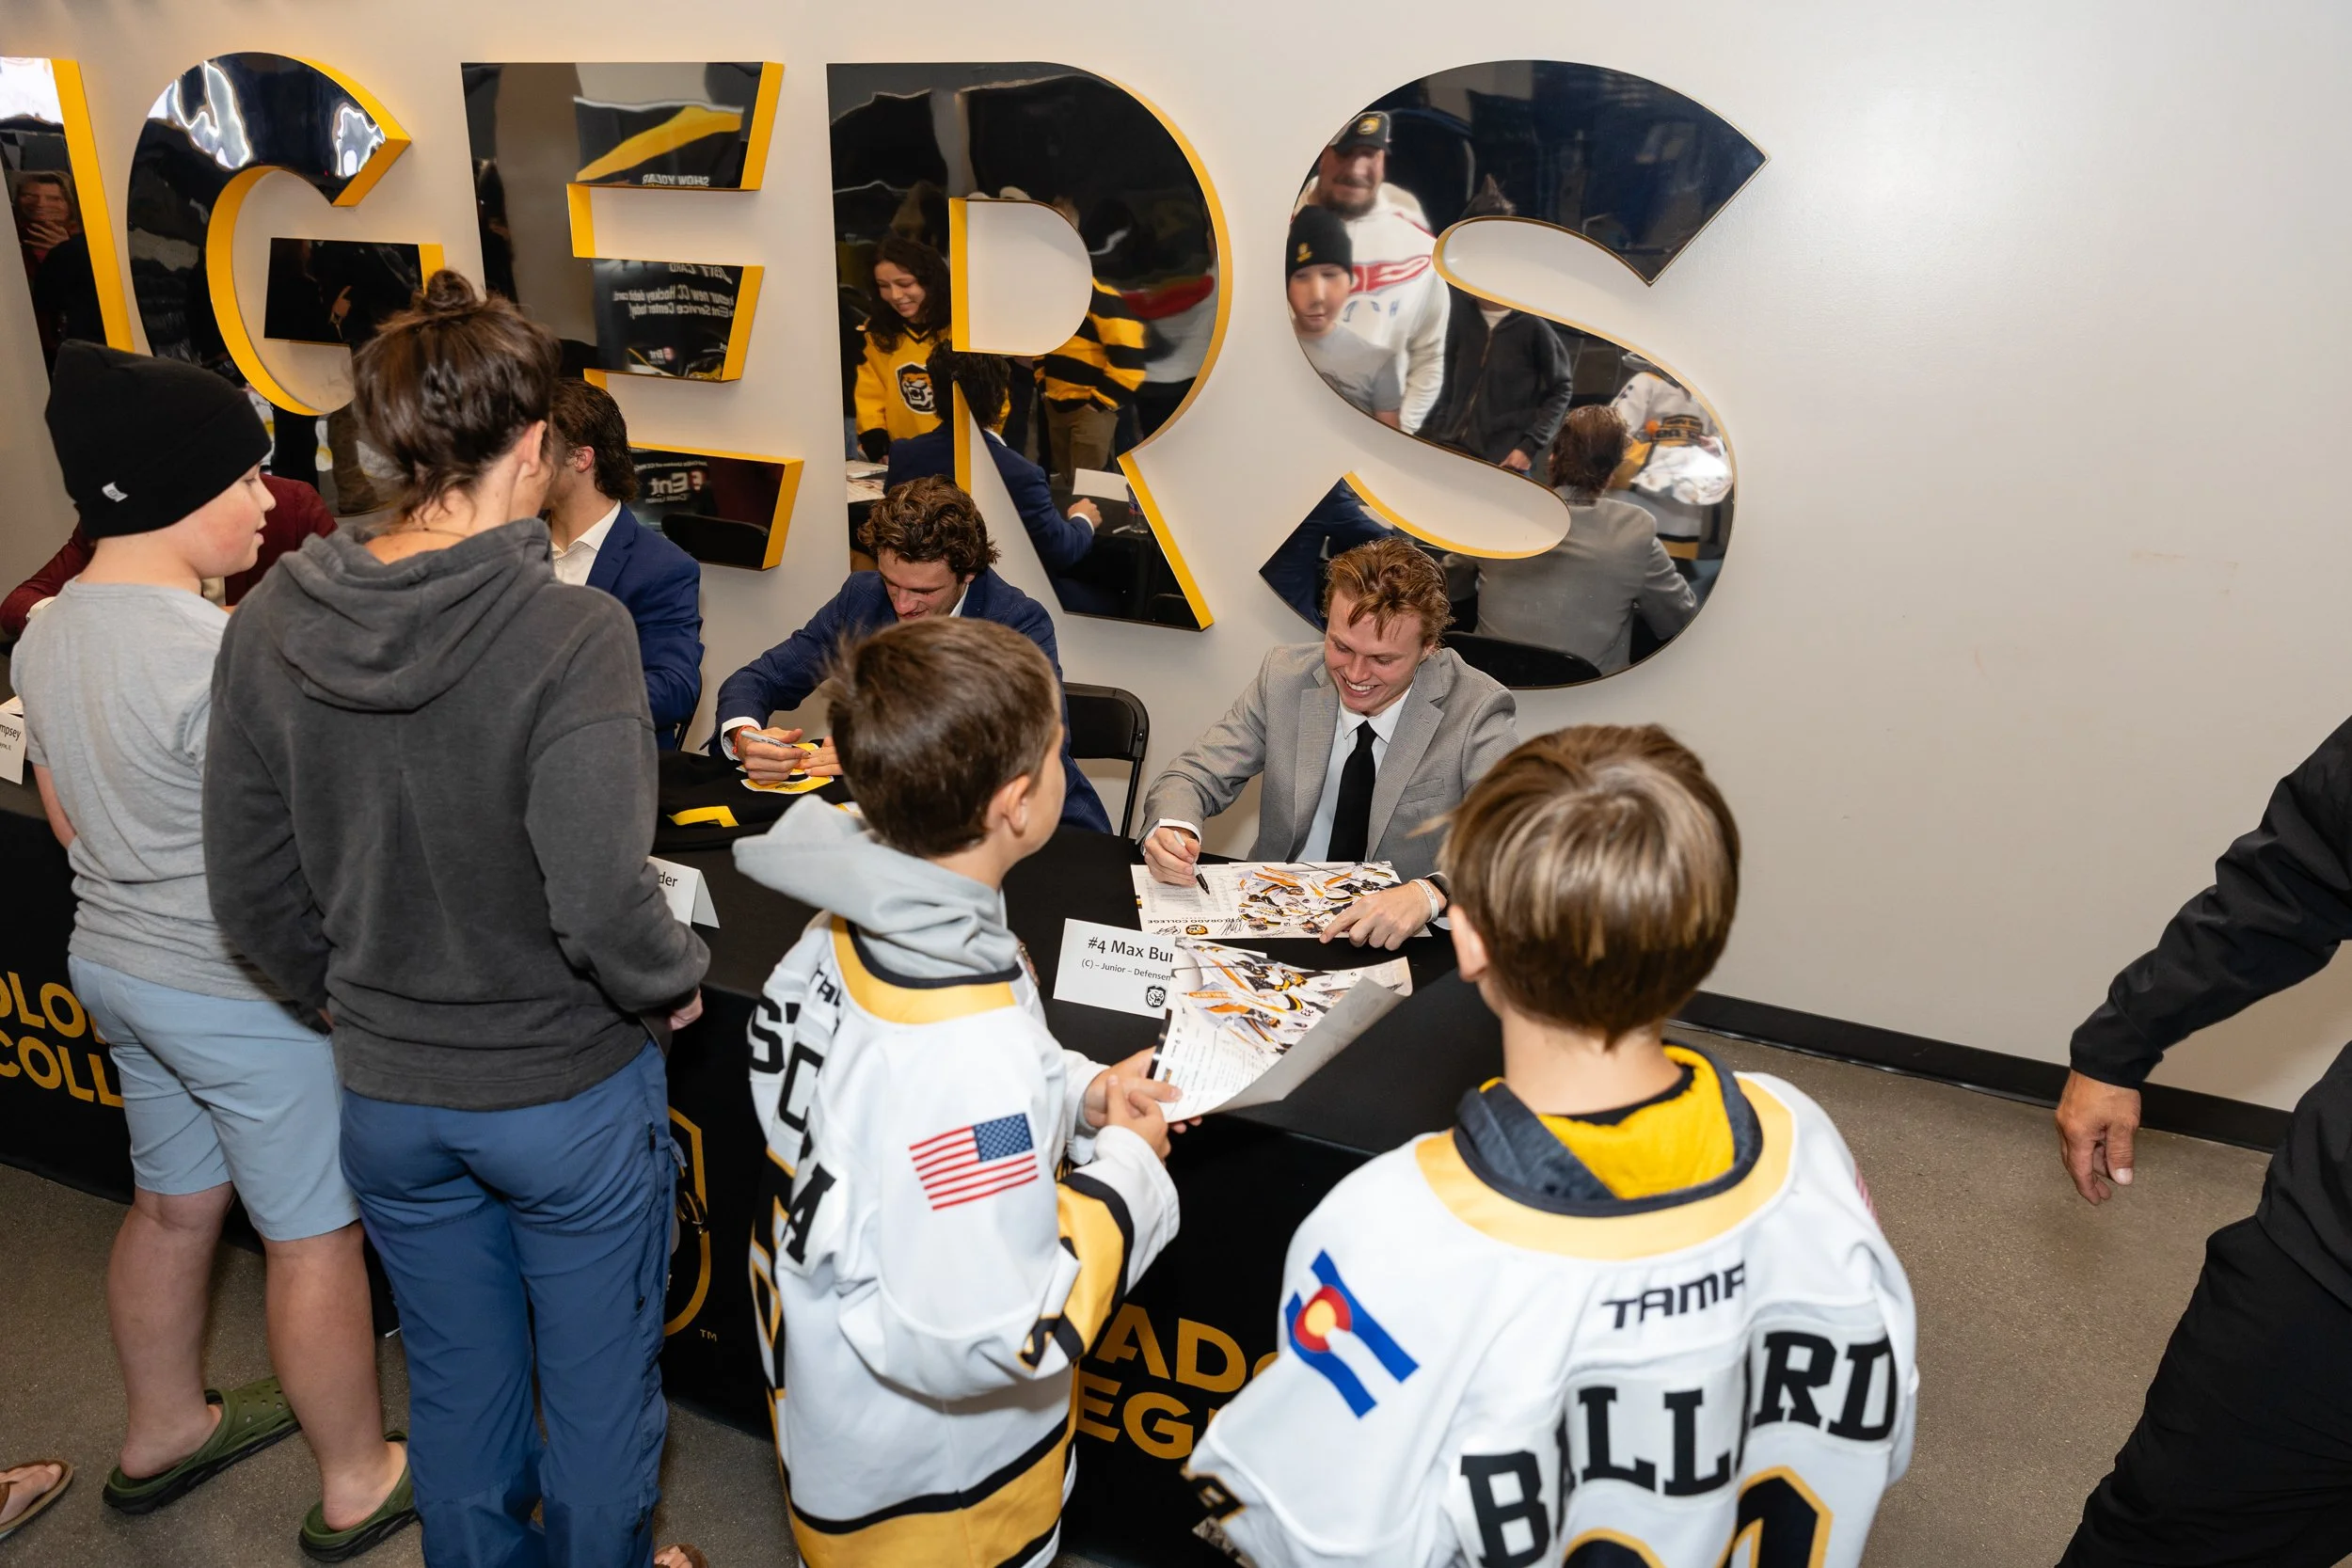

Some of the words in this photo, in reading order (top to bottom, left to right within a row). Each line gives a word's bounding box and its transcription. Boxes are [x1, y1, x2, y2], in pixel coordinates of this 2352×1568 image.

[659, 871, 678, 887] der
[1088, 936, 1106, 954] #4
[1110, 940, 1145, 958] Max
[1081, 958, 1093, 969] (C)
[1101, 962, 1126, 974] Junior
[700, 1328, 718, 1342] TM
[1075, 1369, 1220, 1460] EG
[1460, 1329, 1899, 1568] BLLRD
